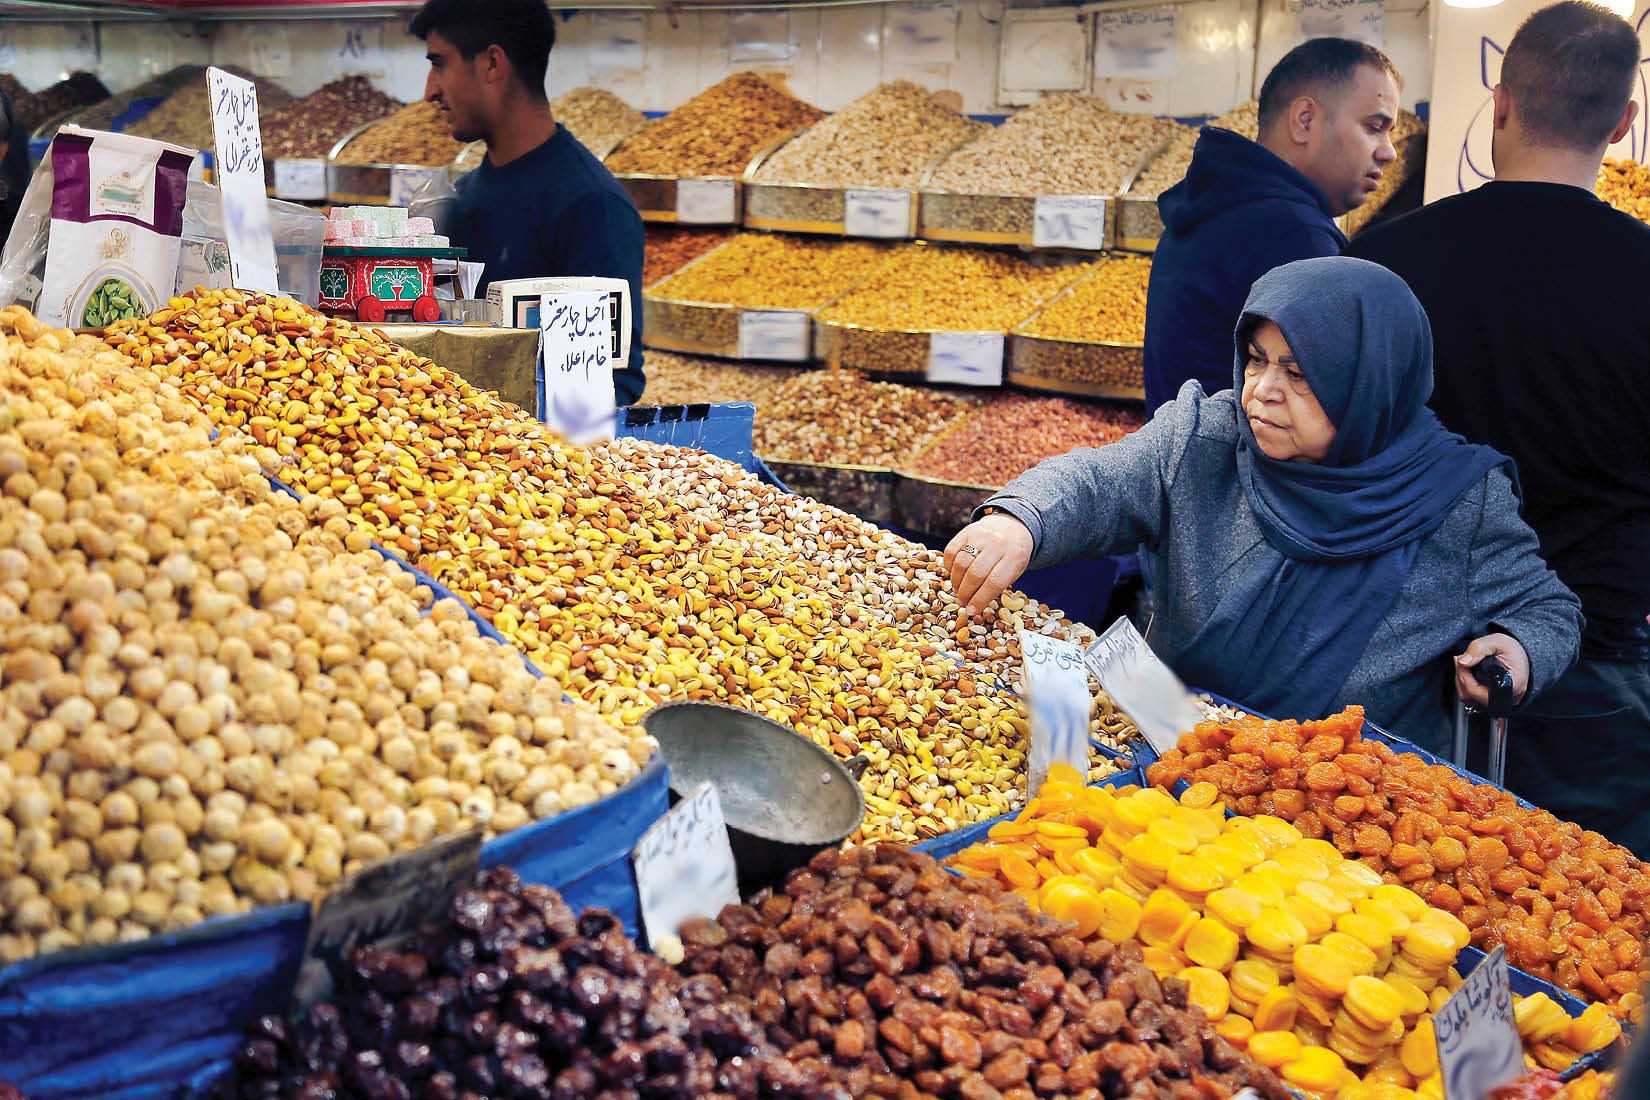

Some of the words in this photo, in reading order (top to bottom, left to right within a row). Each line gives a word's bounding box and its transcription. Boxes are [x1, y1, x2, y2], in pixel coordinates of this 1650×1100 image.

[236, 85, 255, 132] آجیل
[576, 294, 608, 337] آجیل
[585, 345, 607, 384] خام
